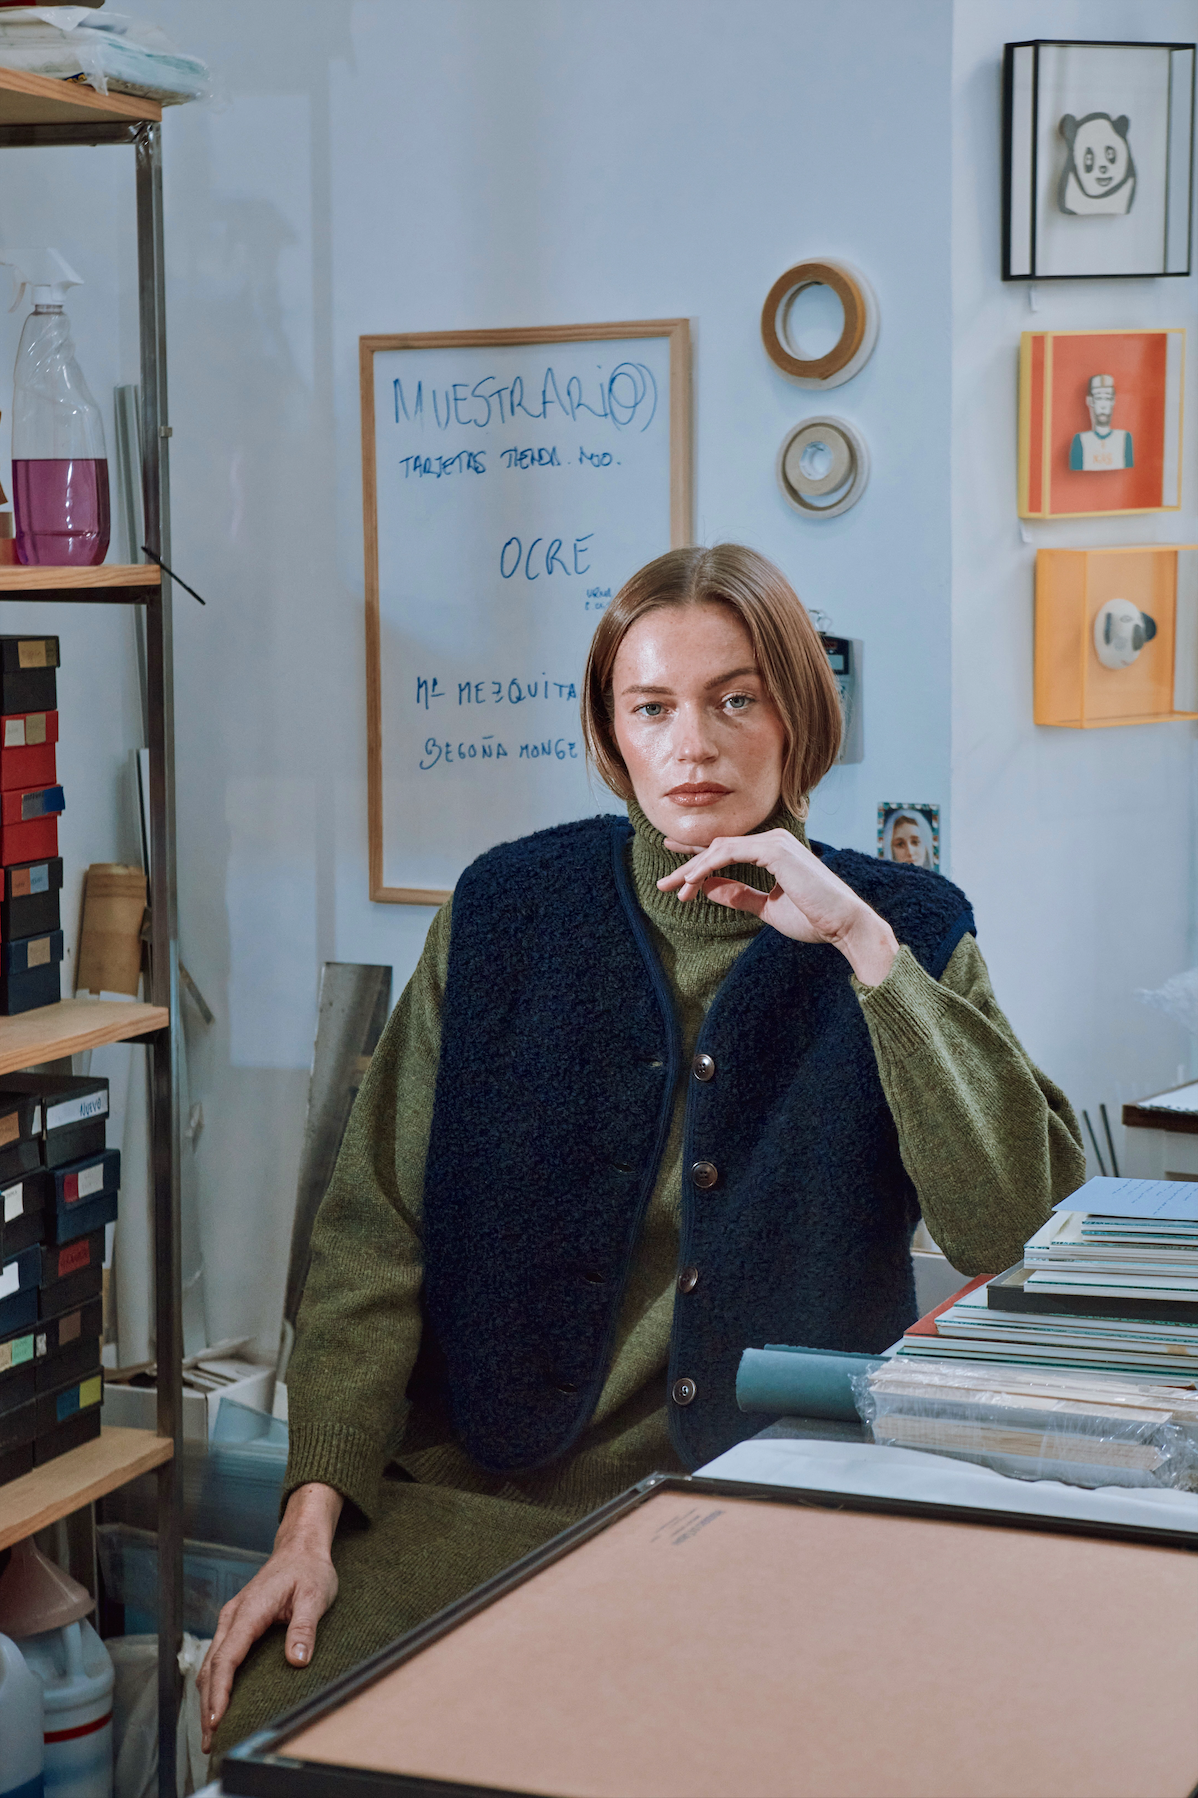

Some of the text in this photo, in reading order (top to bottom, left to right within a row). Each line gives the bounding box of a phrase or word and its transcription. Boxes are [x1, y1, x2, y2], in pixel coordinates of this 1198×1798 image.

[399, 450, 487, 479] TARJETAS
[500, 533, 595, 581] OCRE
[419, 735, 578, 770] BEGOÑA MONGE
[79, 1097, 102, 1117] NUEVO
